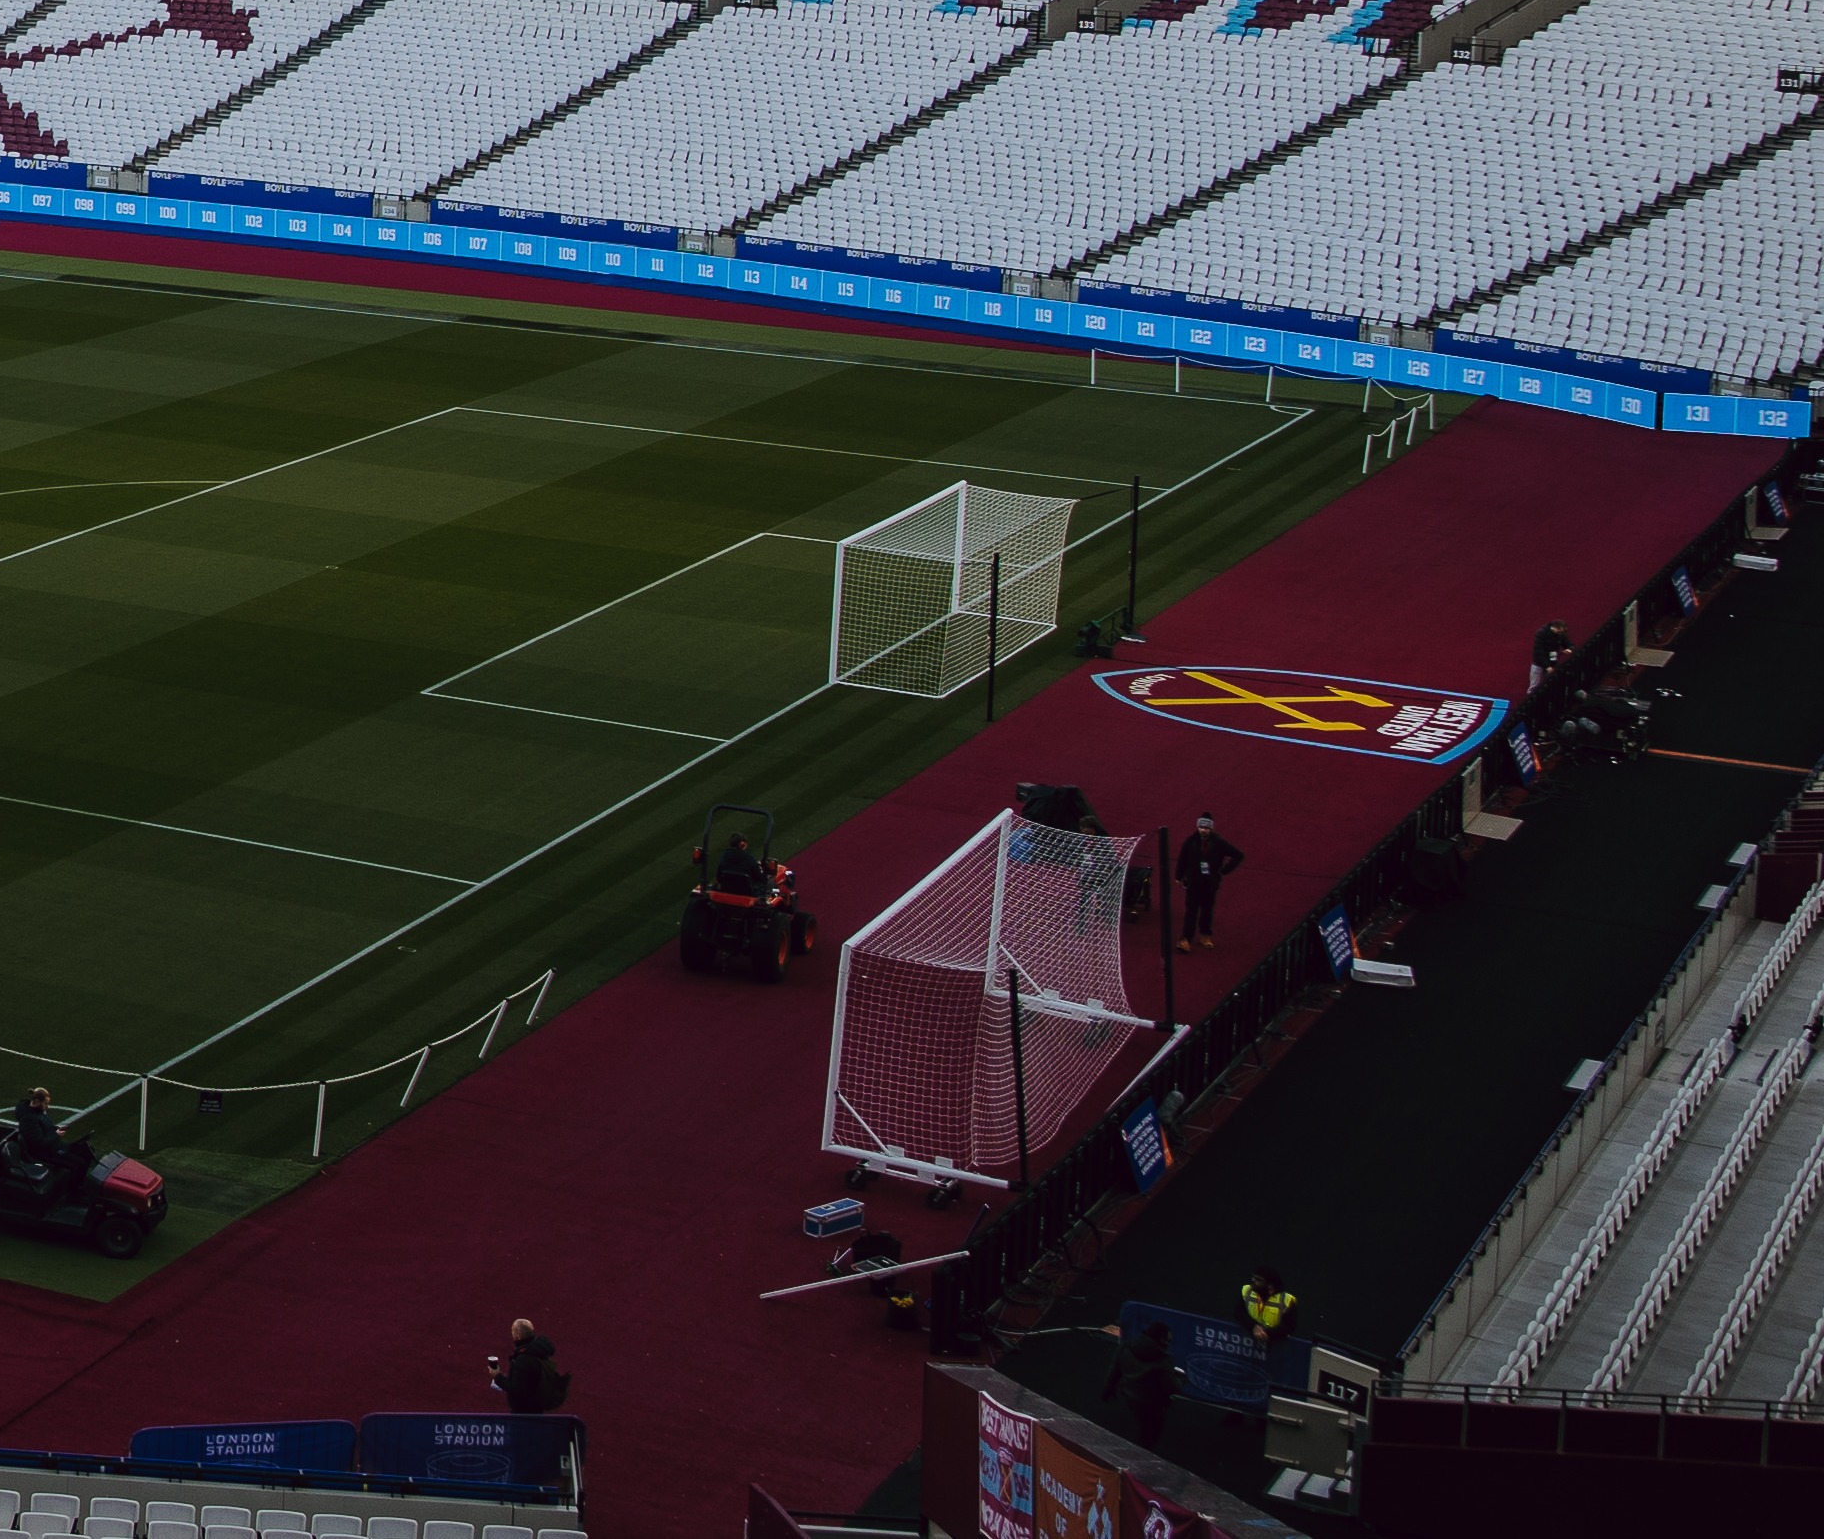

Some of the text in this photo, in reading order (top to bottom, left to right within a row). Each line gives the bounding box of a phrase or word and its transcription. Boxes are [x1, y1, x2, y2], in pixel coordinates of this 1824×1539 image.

[1453, 50, 1470, 59] 132
[1781, 79, 1798, 87] 131
[33, 194, 51, 207] 097
[202, 211, 216, 223] 101
[378, 228, 396, 241] 105
[559, 247, 576, 261] 109
[745, 270, 760, 284] 113
[934, 295, 951, 309] 117
[1086, 315, 1106, 330] 120
[1245, 337, 1266, 352] 123
[1408, 360, 1429, 376] 126
[1520, 377, 1541, 394] 128
[1687, 406, 1709, 421] 131
[1760, 410, 1788, 427] 132
[1195, 1325, 1267, 1350] LONDON
[1194, 1336, 1267, 1361] STADIUM
[1327, 1381, 1359, 1404] 117
[435, 1424, 505, 1435] LONDON
[206, 1432, 275, 1445] LONDON
[434, 1435, 504, 1446] STADIUM
[206, 1444, 274, 1456] STADIUM
[1040, 1468, 1083, 1517] ACADEMY
